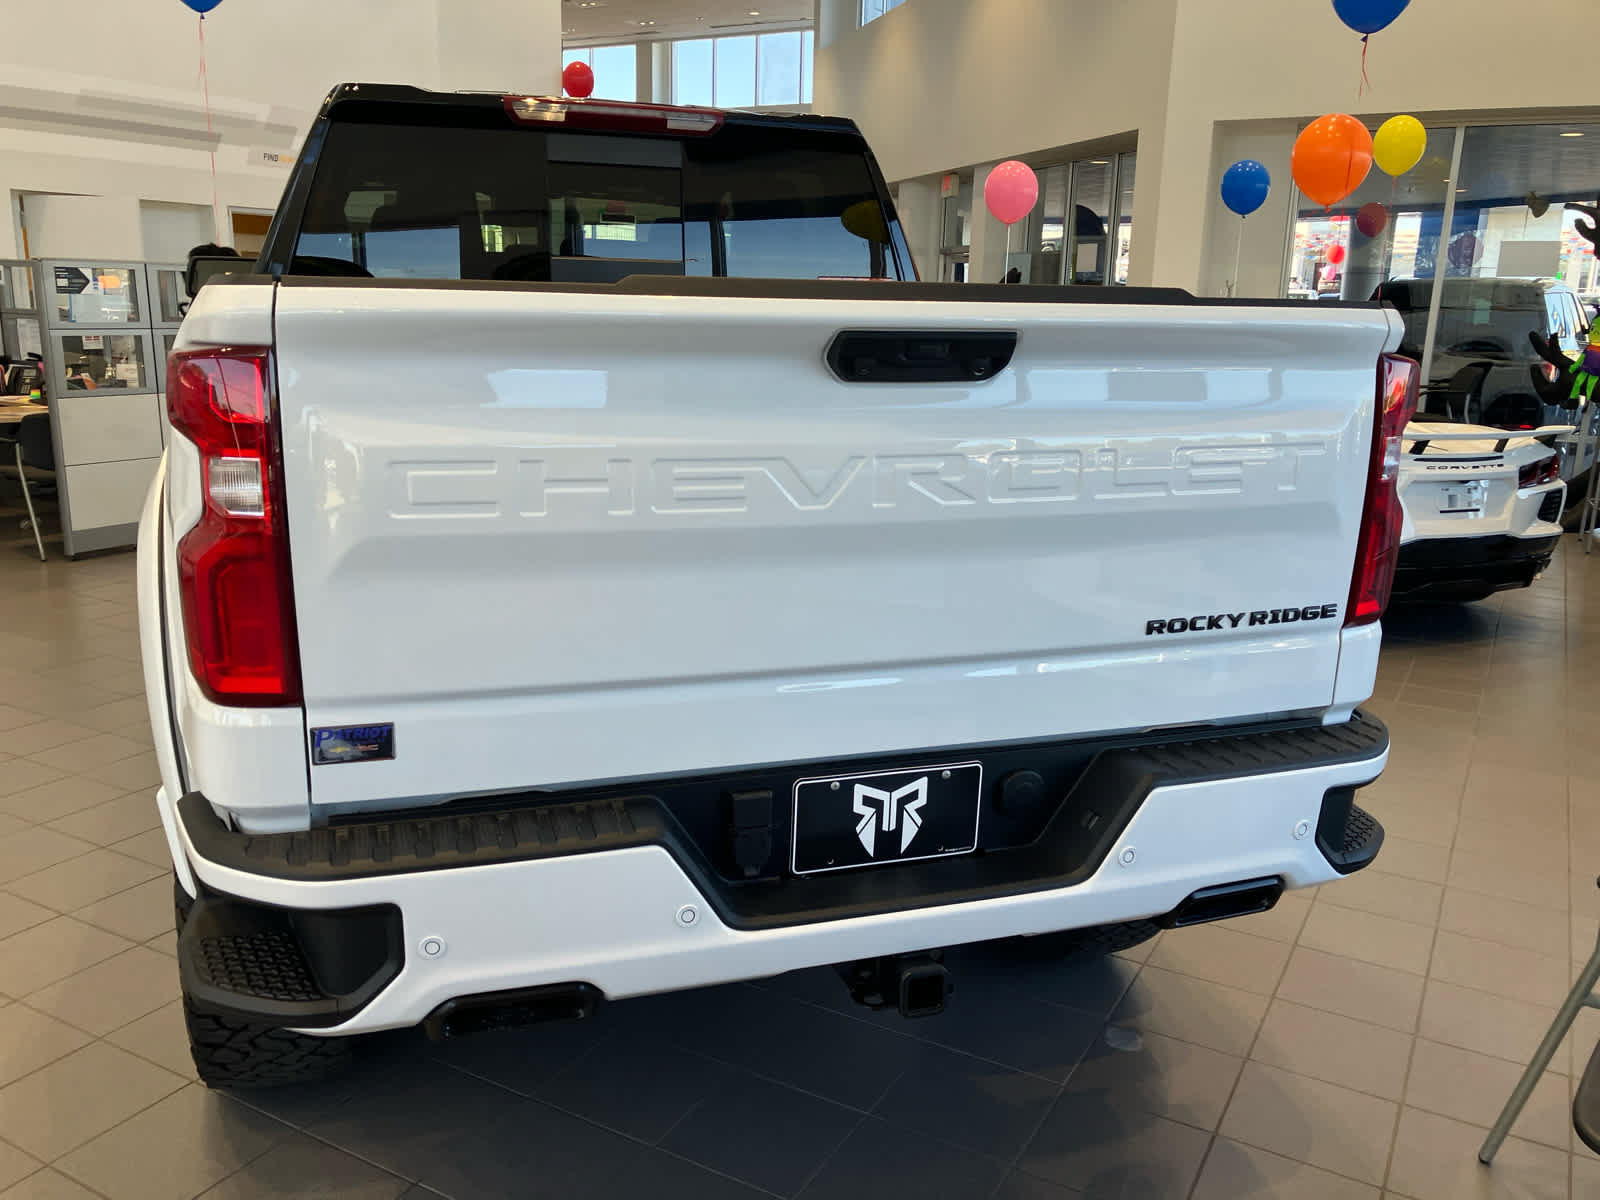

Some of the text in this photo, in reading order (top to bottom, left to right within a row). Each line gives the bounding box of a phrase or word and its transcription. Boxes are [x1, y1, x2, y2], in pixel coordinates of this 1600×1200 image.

[384, 443, 1326, 520] CHEVROLET
[1145, 603, 1338, 636] ROCKY RIDGE
[315, 726, 392, 748] PATRIOT
